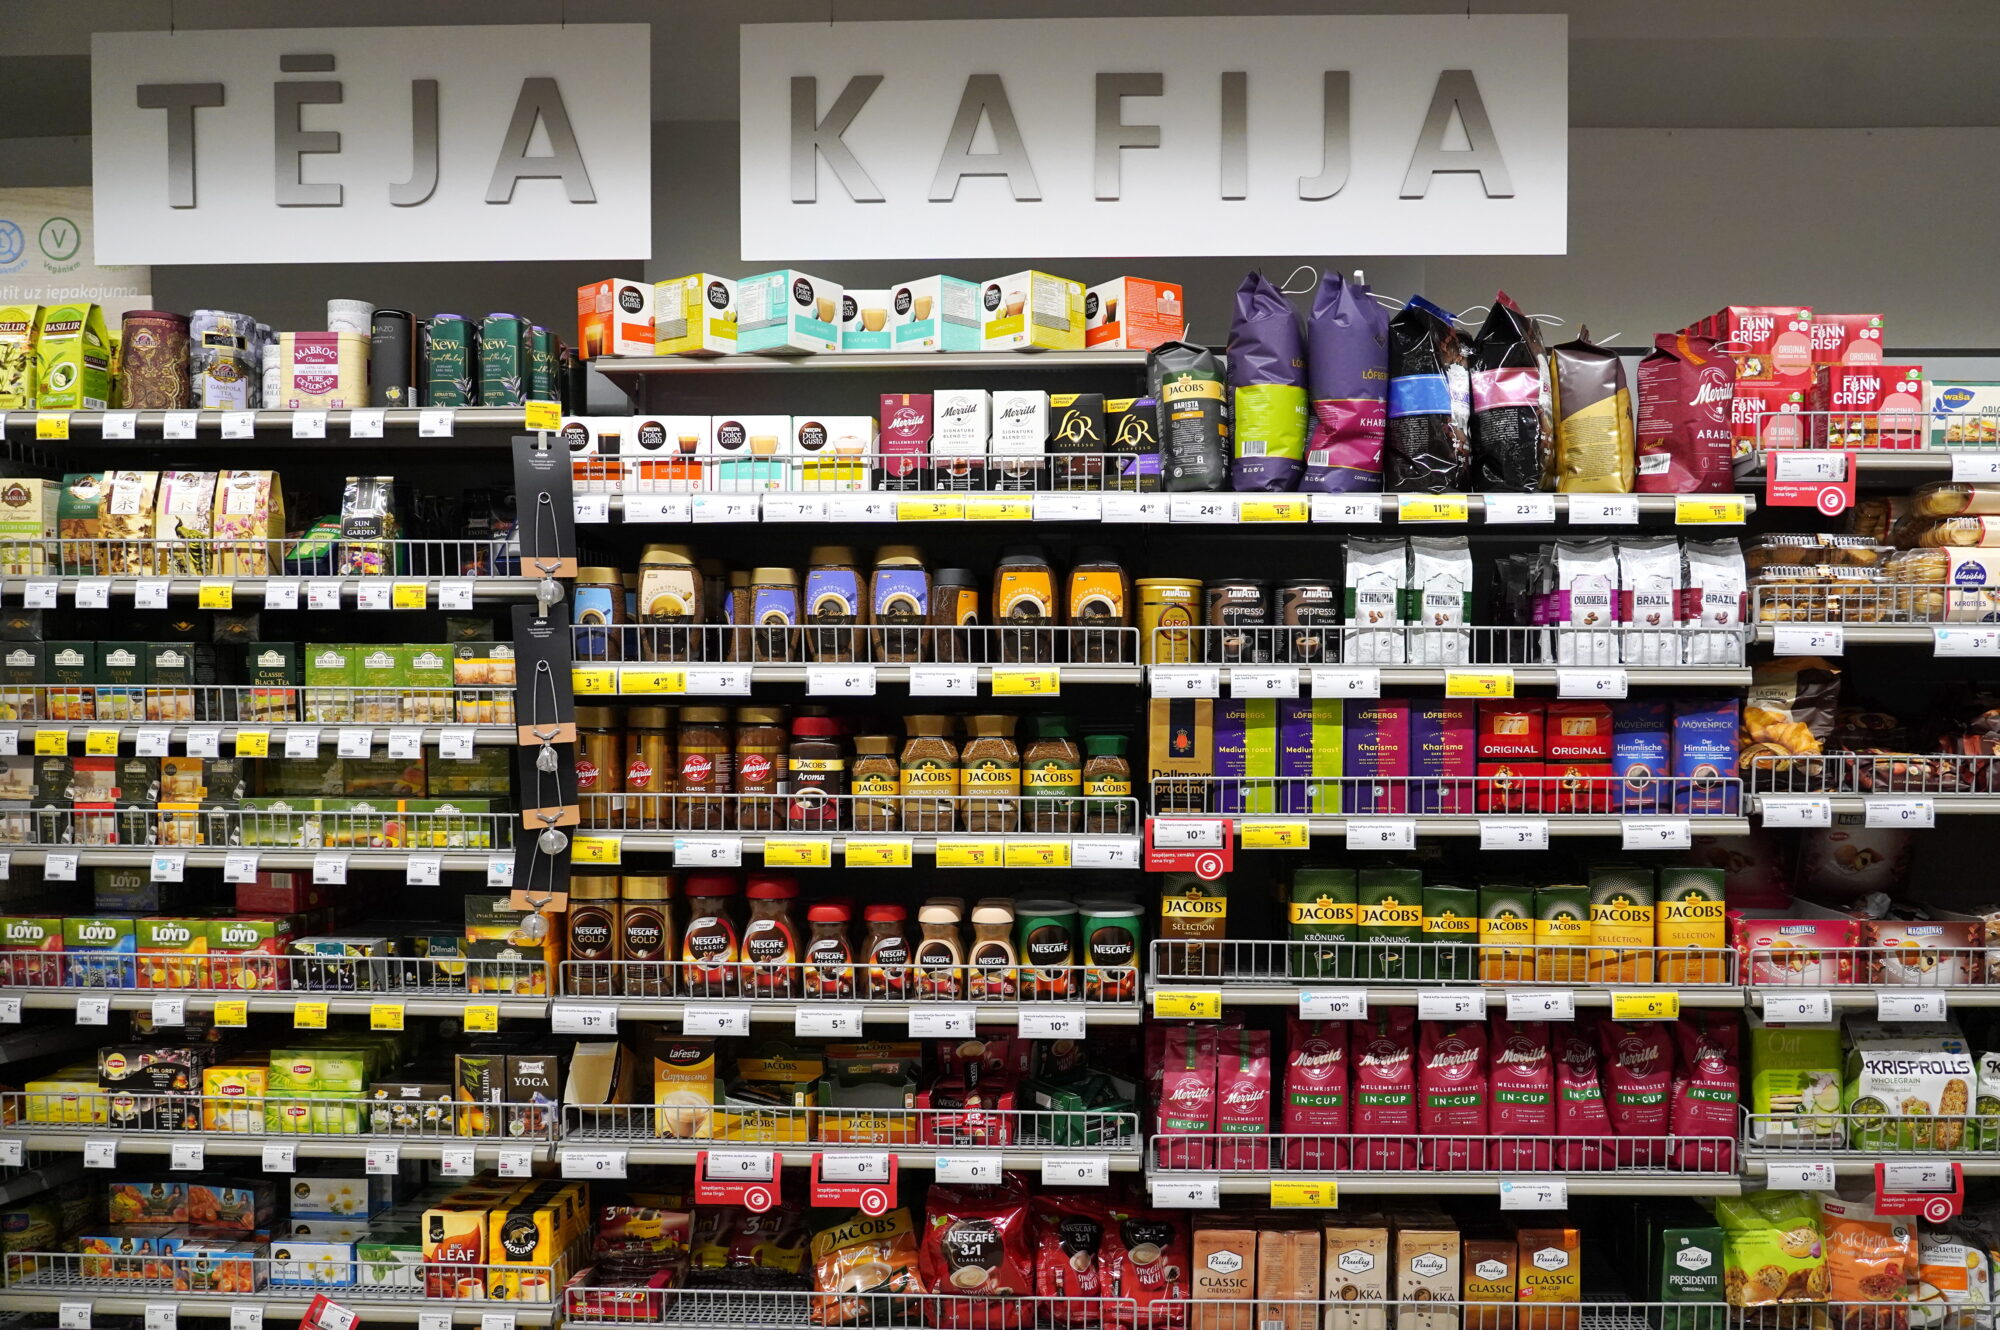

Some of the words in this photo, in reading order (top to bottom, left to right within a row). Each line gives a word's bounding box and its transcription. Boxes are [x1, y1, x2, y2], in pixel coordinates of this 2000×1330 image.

[136, 53, 598, 209] TĒJA
[790, 69, 1515, 205] KAFIJA
[0, 284, 20, 298] tīt
[23, 287, 42, 299] uz
[45, 282, 138, 303] iepakojuma
[45, 321, 80, 333] BASILUR
[1740, 316, 1774, 330] FINN
[1731, 330, 1770, 343] CRISP
[1811, 324, 1845, 338] FINN
[431, 338, 459, 351] Kew
[482, 338, 508, 351] Kew
[1779, 344, 1807, 354] ORIGINAL
[295, 346, 337, 360] MABROC
[210, 384, 242, 392] GAMPOLA
[1843, 377, 1881, 391] FINN
[1833, 390, 1878, 405] CRISP
[1943, 392, 1971, 402] wasa
[941, 403, 977, 418] Merrild
[1000, 405, 1036, 420] Merrild
[641, 430, 662, 440] Dolce
[720, 431, 743, 440] Dolce
[802, 432, 824, 440] Dolce
[643, 438, 662, 446] Gusto
[721, 438, 742, 446] Gusto
[1372, 450, 1381, 464] 4
[73, 503, 91, 511] GREEN
[347, 528, 376, 536] GARDEN
[1162, 589, 1191, 598] LAVAZZA
[1228, 589, 1260, 599] LAVAZZA
[1302, 589, 1333, 599] LAVAZZA
[1360, 592, 1394, 604] ETHIOPIA
[1705, 593, 1737, 605] BRAZIL
[1426, 595, 1460, 606] ETHIOPIA
[1636, 595, 1670, 606] BRAZIL
[1222, 607, 1265, 619] espresso
[1297, 607, 1336, 619] espresso
[255, 678, 276, 686] BLACK
[277, 678, 290, 686] TEA
[1681, 719, 1733, 729] MÖVENPICK
[1357, 742, 1398, 751] Kharisma
[1423, 742, 1463, 751] Kharisma
[1484, 745, 1538, 754] ORIGINAL
[1683, 744, 1730, 752] Himmlische
[682, 761, 712, 775] Merrild
[740, 760, 771, 774] Merrild
[798, 773, 825, 783] Aroma
[907, 770, 952, 784] JACOBS
[1029, 770, 1073, 784] JACOBS
[1164, 901, 1222, 914] JACOBS
[1664, 905, 1723, 920] JACOBS
[1296, 907, 1354, 921] JACOBS
[1361, 908, 1419, 923] JACOBS
[1590, 908, 1651, 923] JACOBS
[6, 923, 44, 940] LOYD
[78, 925, 117, 940] LOYD
[1172, 923, 1215, 931] SELECTION
[1779, 926, 1816, 936] MAGDALENAS
[152, 926, 190, 942] LOYD
[221, 927, 258, 943] LOYD
[578, 935, 605, 943] GOLD
[631, 936, 657, 944] GOLD
[1598, 936, 1642, 944] SELECTION
[1672, 931, 1716, 940] SELECTION
[430, 945, 457, 954] Dilmah
[428, 975, 462, 984] Lemon
[669, 1048, 701, 1060] LaFesta
[1427, 1048, 1480, 1069] Merrild
[146, 1067, 161, 1075] EARL
[161, 1067, 176, 1075] GREY
[293, 1065, 311, 1074] Lipton
[1865, 1059, 1970, 1075] KRISPROLLS
[661, 1069, 708, 1083] Cappuccino
[514, 1077, 550, 1088] YOGA
[1617, 1083, 1666, 1091] MELLEMRISTET
[223, 1085, 243, 1095] Lipton
[1169, 1086, 1210, 1101] Merrild
[1622, 1094, 1663, 1104] IN-CUP
[288, 1108, 306, 1116] Lipton
[1172, 1120, 1205, 1129] IN-CUP
[1226, 1124, 1261, 1132] IN-CUP
[827, 1217, 896, 1249] JACOBS
[503, 1238, 536, 1255] MOZUMS
[1921, 1244, 1963, 1255] baguette
[438, 1249, 475, 1262] LEAF
[1535, 1253, 1566, 1265] Paulig
[1678, 1253, 1709, 1266] Paulig
[1210, 1256, 1241, 1269] Paulig
[1341, 1255, 1372, 1269] Paulig
[1414, 1259, 1445, 1272] Paulig
[1478, 1264, 1506, 1276] Paulig
[1200, 1277, 1248, 1288] CLASSIC
[1669, 1275, 1718, 1285] PRESIDENTTI
[575, 1305, 605, 1313] express
